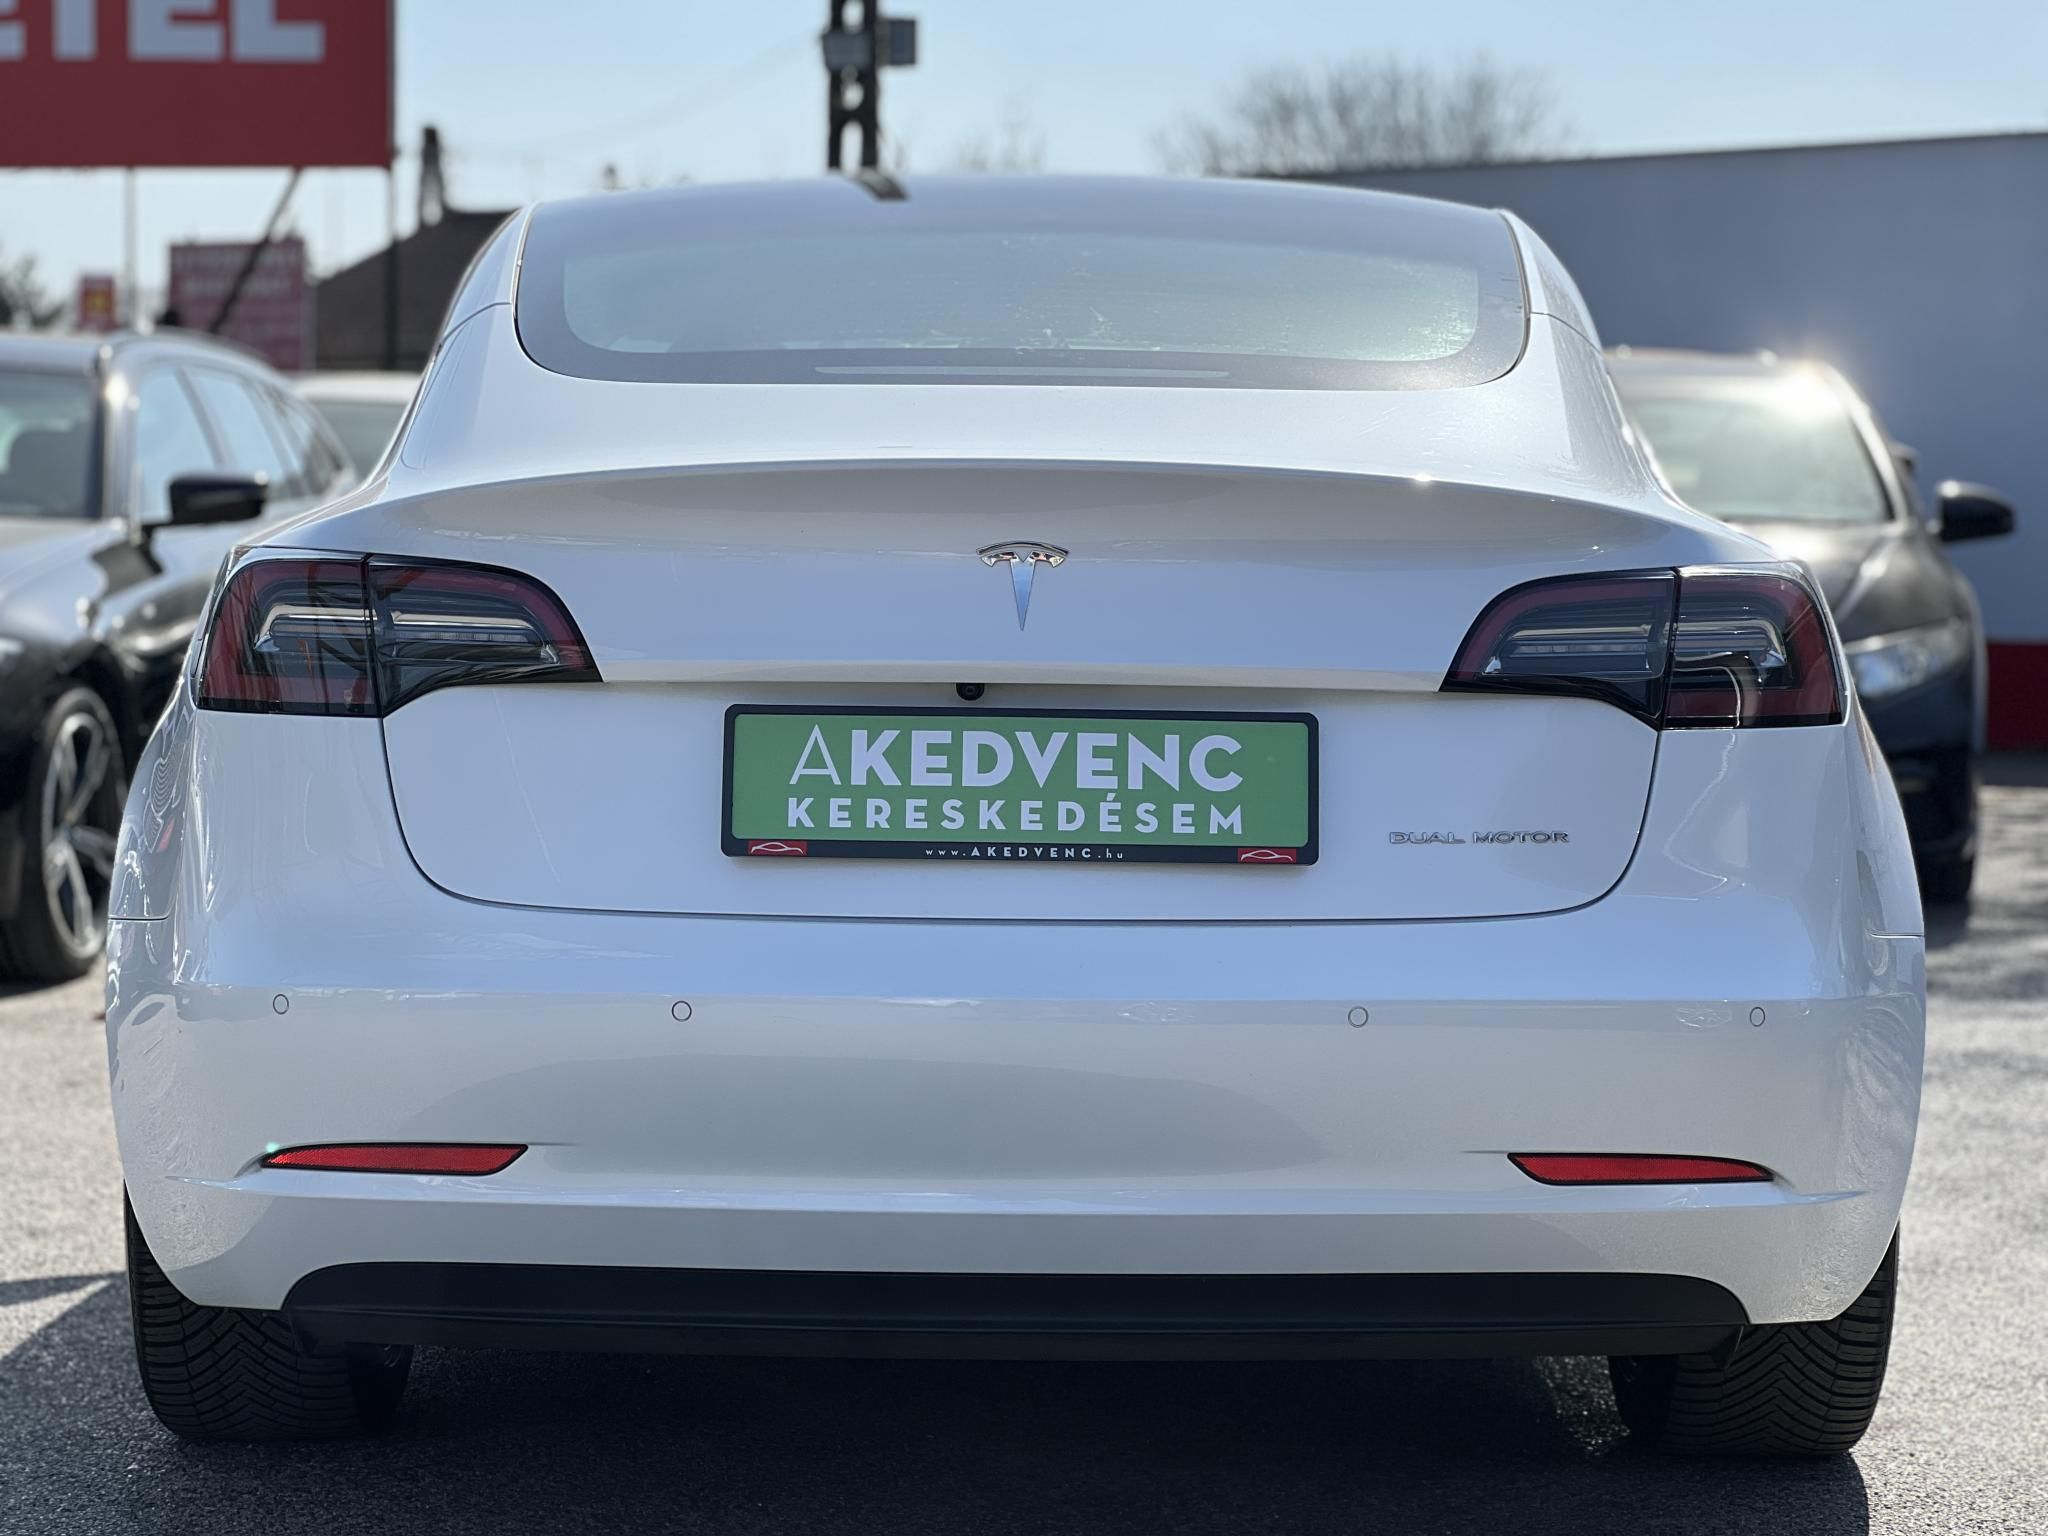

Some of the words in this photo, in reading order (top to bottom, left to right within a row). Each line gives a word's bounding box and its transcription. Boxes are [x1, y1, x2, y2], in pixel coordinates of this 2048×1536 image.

[788, 723, 1244, 792] AKEDVENC
[786, 792, 1243, 835] KERESKEDÉSEM
[1389, 831, 1466, 844] DUAL
[1472, 830, 1570, 844] MOTOR
[925, 846, 1124, 860] www.AKEDVENC.hu
